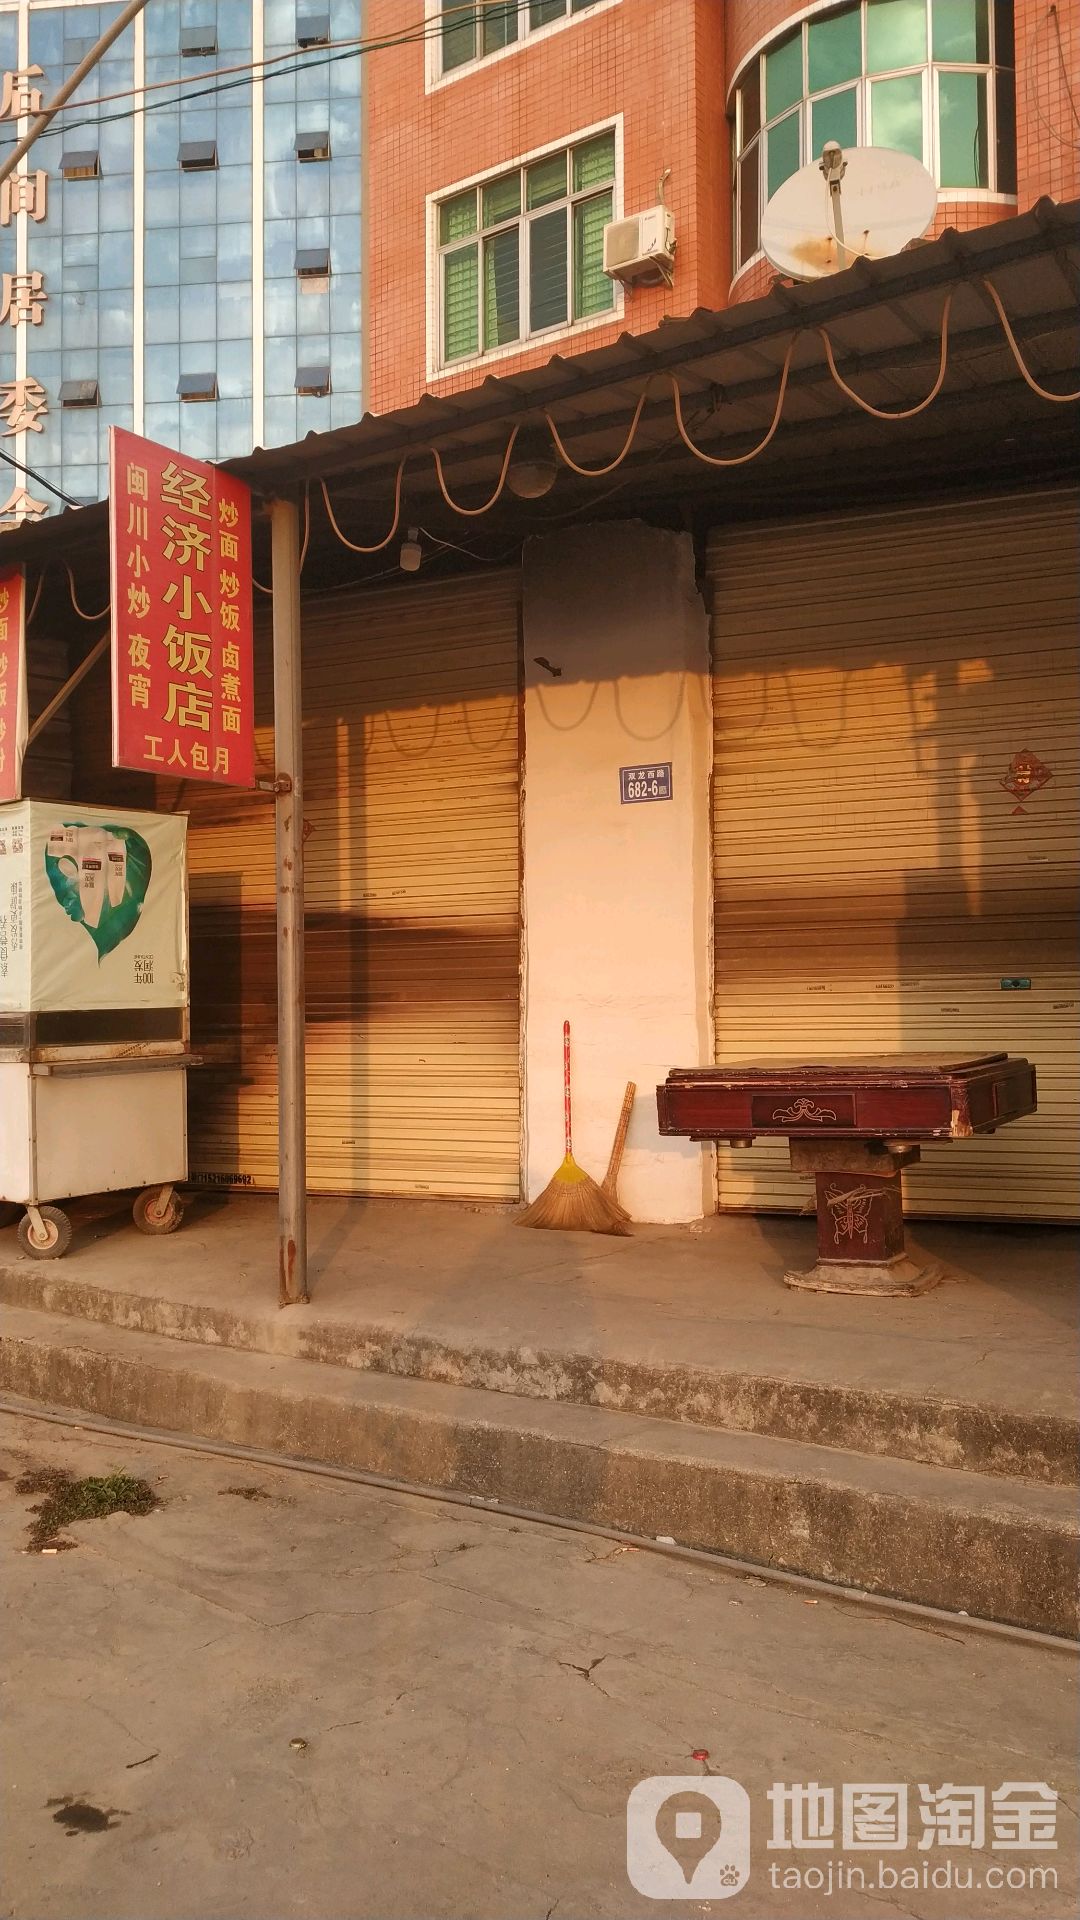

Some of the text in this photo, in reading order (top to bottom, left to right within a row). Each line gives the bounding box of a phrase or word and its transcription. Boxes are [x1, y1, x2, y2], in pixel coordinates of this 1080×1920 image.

[126, 462, 151, 710] 闽川小炒 夜宵
[160, 461, 214, 732] 经济小饭店
[218, 498, 241, 735] 炒面 炒饭 卤煮面
[143, 735, 230, 776] 工人包月
[628, 769, 665, 780] 双龙西路
[628, 780, 658, 798] 682-6
